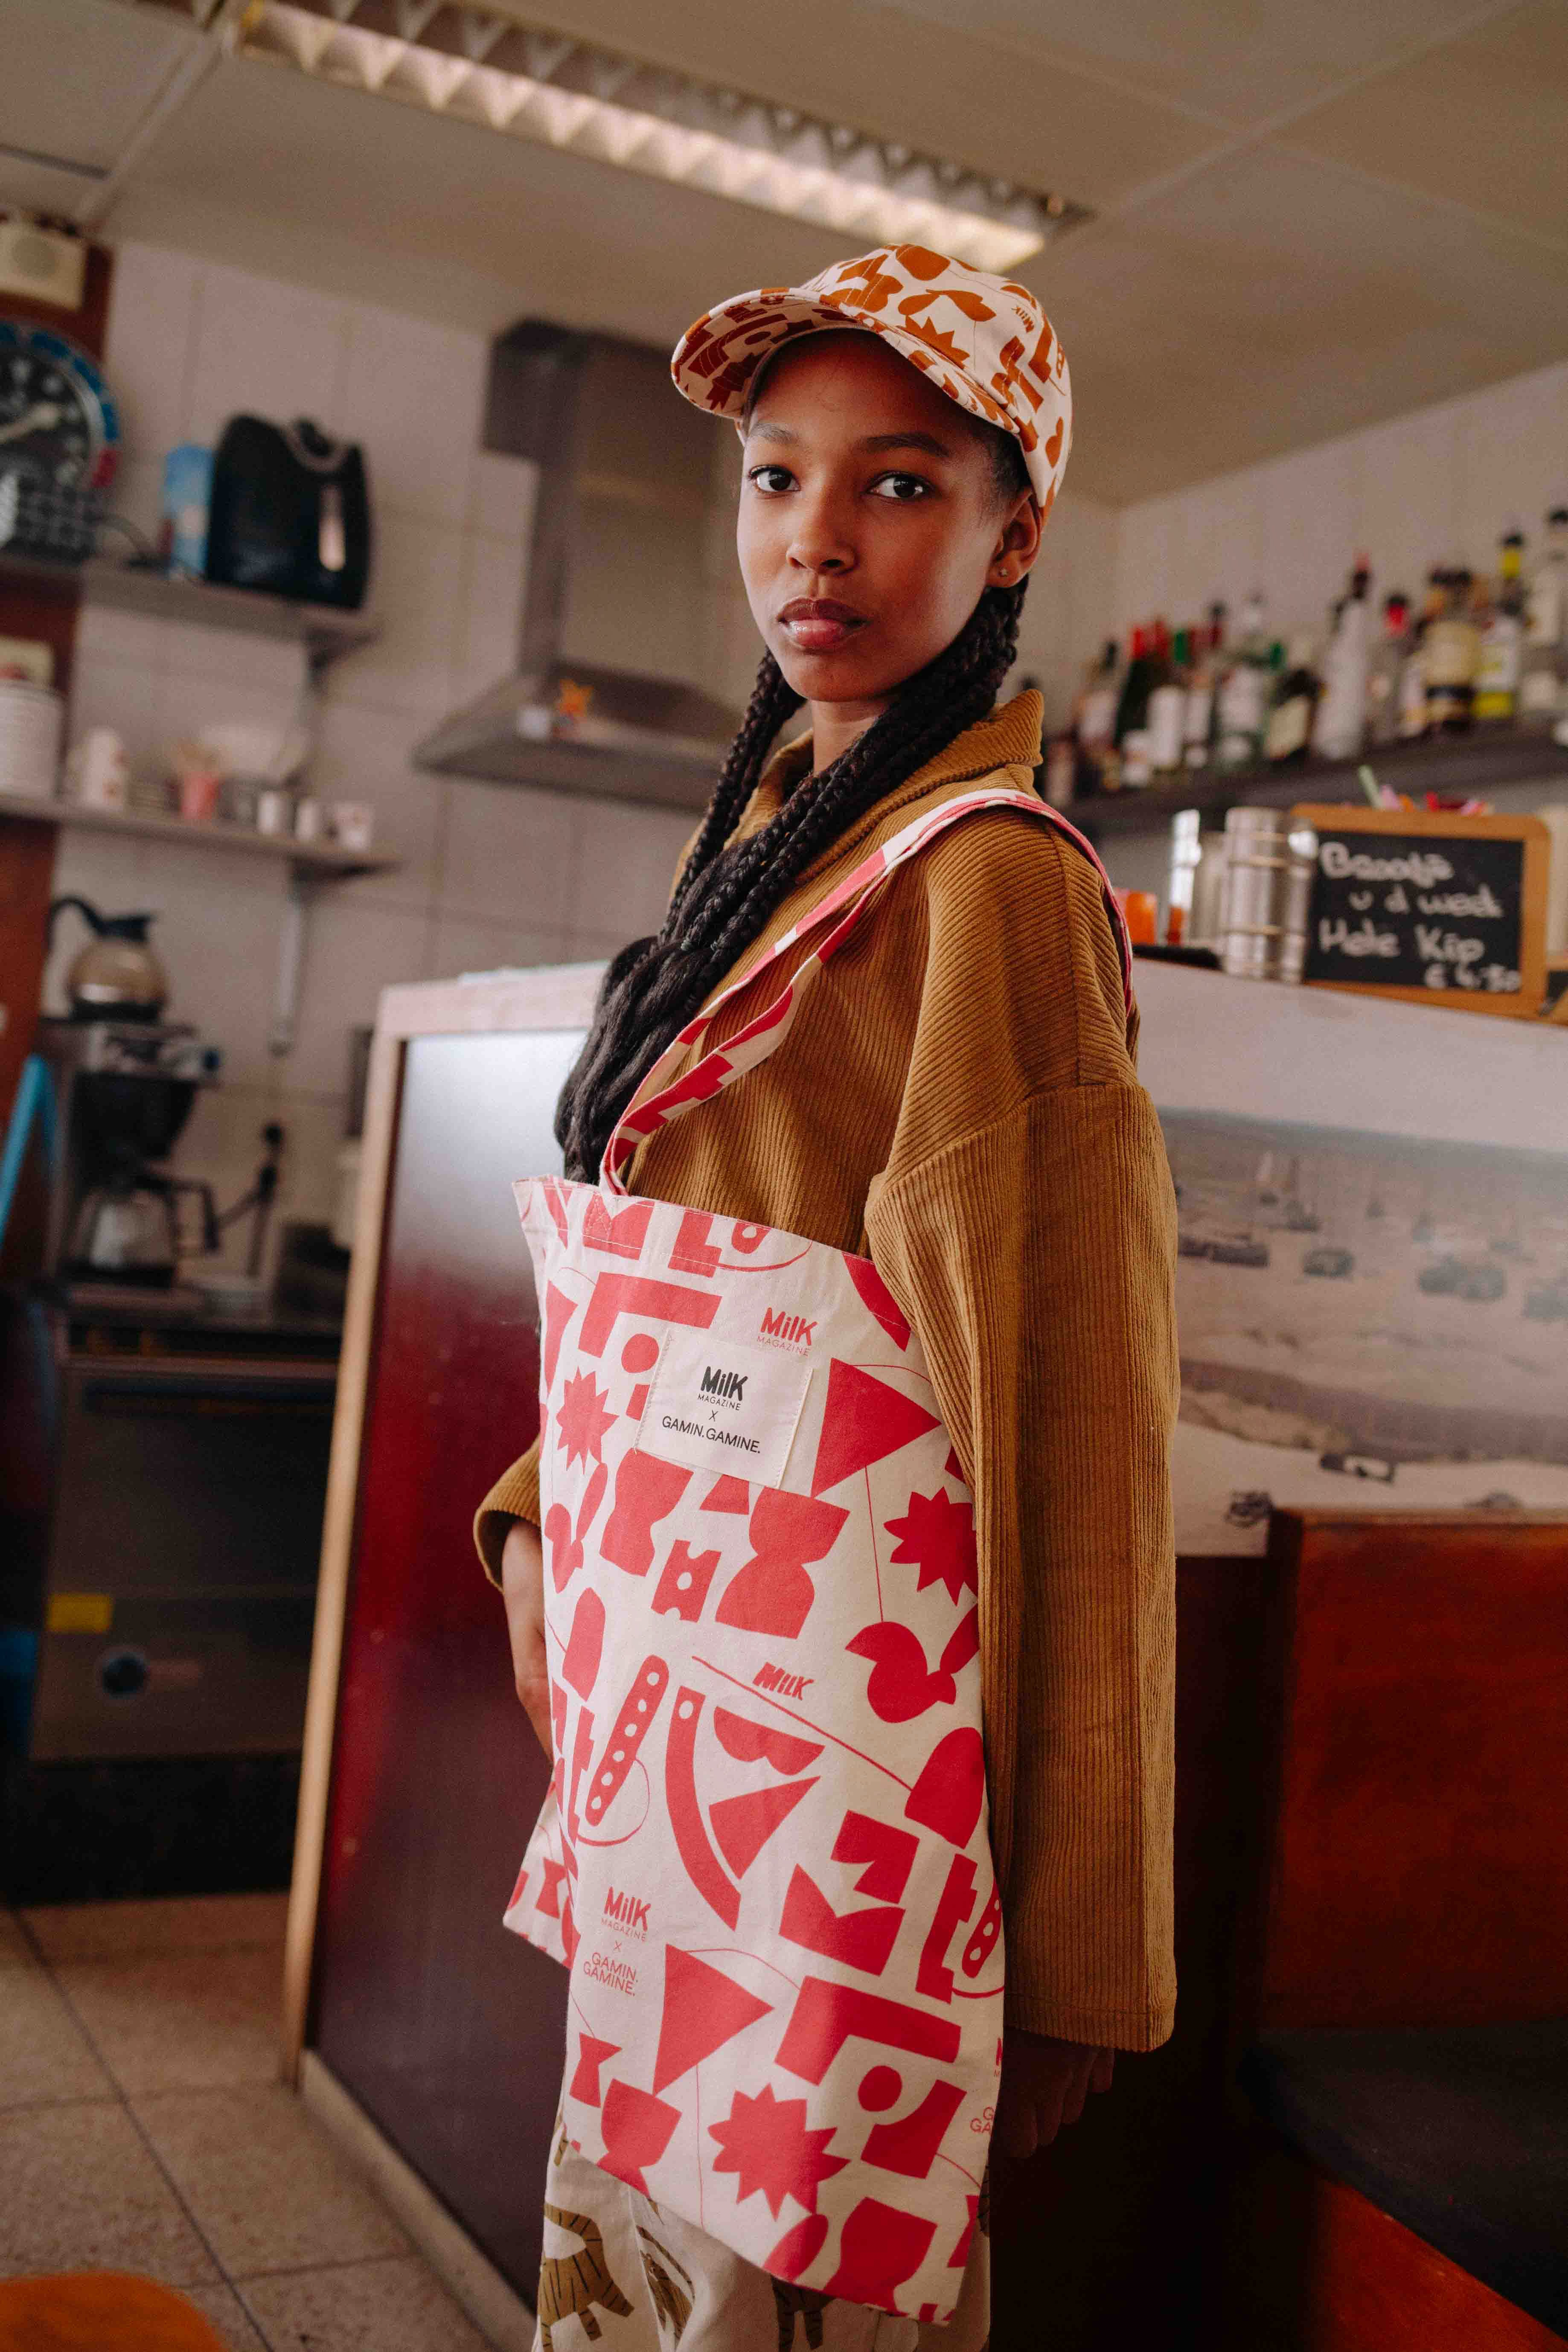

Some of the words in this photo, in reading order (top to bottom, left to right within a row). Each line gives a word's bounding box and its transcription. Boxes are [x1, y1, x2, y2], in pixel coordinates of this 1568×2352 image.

[1415, 925, 1484, 962] Kip
[757, 1336, 811, 1357] MAGAZINE
[698, 1394, 741, 1411] MAGAZINE
[601, 1918, 646, 1941] MAGAZINE
[583, 1961, 635, 1996] GAMINE.
[592, 1952, 638, 1983] GAMIN.
